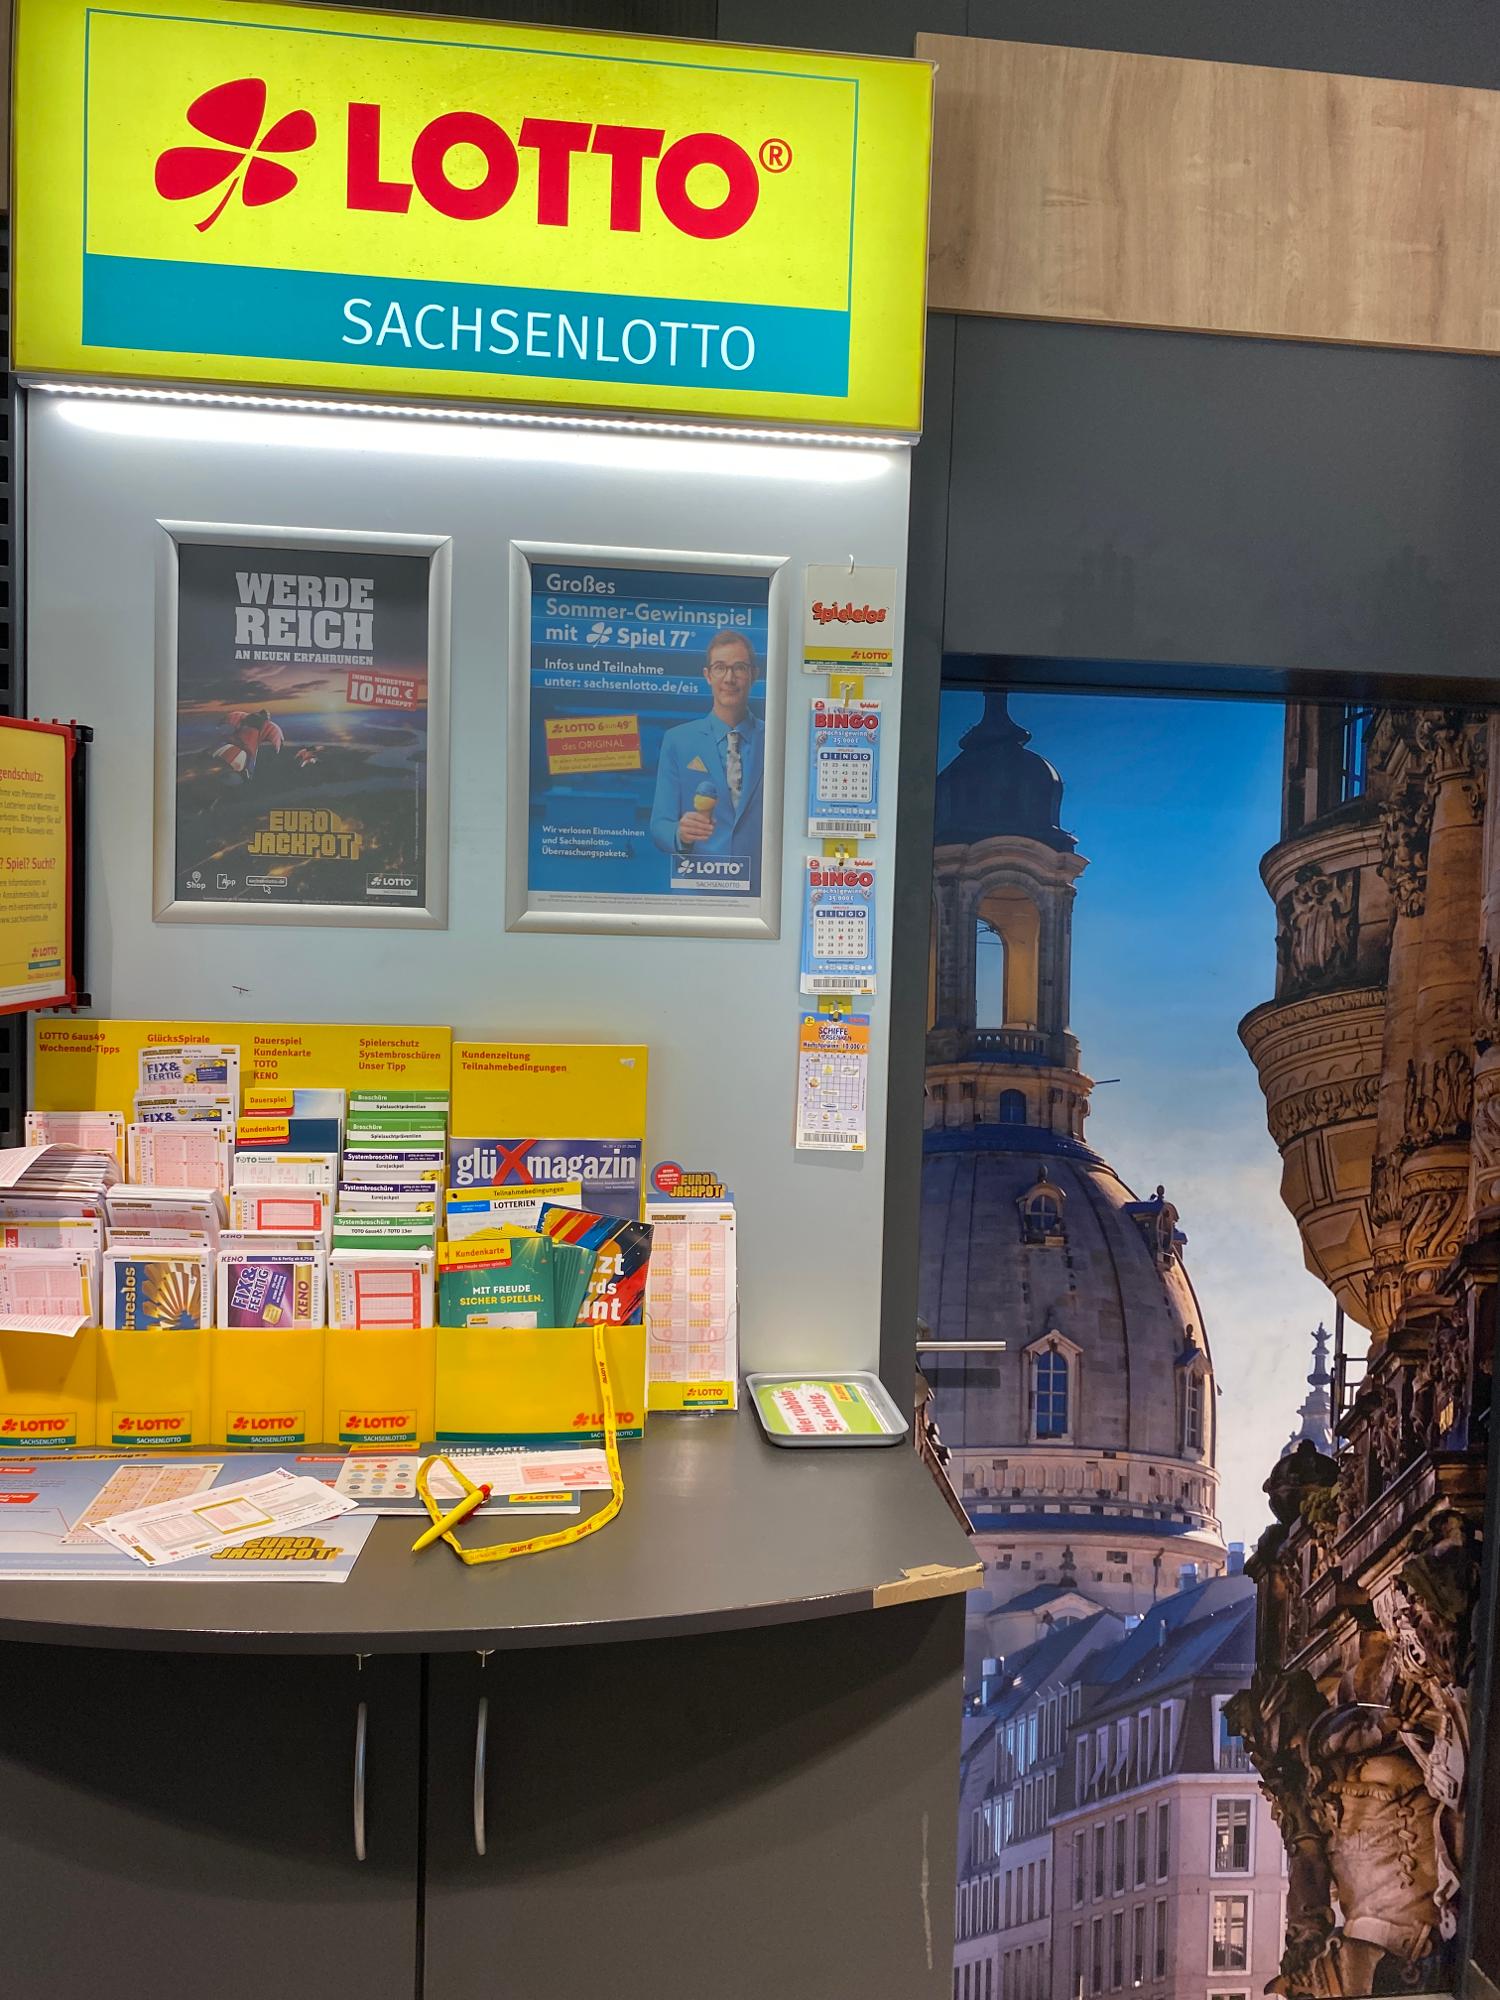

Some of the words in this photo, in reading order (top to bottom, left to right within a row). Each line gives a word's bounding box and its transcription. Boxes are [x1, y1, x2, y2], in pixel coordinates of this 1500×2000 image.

[342, 298, 757, 372] SACHSENLOTTO
[545, 573, 616, 595] Großes
[235, 572, 375, 611] WERDE
[545, 597, 753, 628] Sommer-Gewinnspiel
[234, 606, 375, 651] REICH
[545, 624, 578, 642] mit
[616, 626, 667, 650] Spiel
[234, 650, 252, 661] AN
[253, 650, 292, 663] NEUEN
[293, 652, 374, 666] ERFAHRUNGEN
[862, 652, 888, 660] LOTTO
[544, 658, 575, 672] Infos
[576, 660, 600, 673] und
[602, 659, 664, 675] Teilnahme
[351, 681, 374, 702] 10
[544, 676, 581, 689] unter:
[582, 677, 699, 695] sachsenlotto.de/eis
[815, 712, 879, 730] BINGO
[564, 722, 596, 733] LOTTO
[578, 738, 625, 750] ORIGINAL
[269, 809, 335, 834] EURO
[541, 825, 557, 833] Wir
[558, 825, 592, 835] verlosen
[592, 827, 645, 837] Eismaschinen
[247, 832, 359, 860] JACKPOT
[541, 836, 558, 845] und
[6, 856, 30, 873] Spiel?
[32, 857, 57, 870] Sucht?
[695, 860, 740, 876] LOTTO
[186, 881, 206, 891] Shop
[221, 877, 236, 887] App
[383, 877, 411, 887] LOTTO
[809, 871, 874, 887] BINGO
[39, 1031, 70, 1042] LOTTO
[71, 1032, 106, 1042] 6aus49
[818, 1027, 848, 1036] SCHIFFE
[147, 1033, 211, 1045] GlücksSpirale
[253, 1035, 303, 1047] Dauerspiel
[359, 1038, 420, 1050] Spielerschutz
[39, 1044, 121, 1055] Wochenend-Tipps
[253, 1047, 312, 1058] Kundenkarte
[358, 1049, 442, 1061] Systembroschüren
[461, 1050, 531, 1062] Kundenzeitung
[253, 1059, 279, 1069] TOTO
[358, 1062, 385, 1071] Unser
[386, 1062, 407, 1073] Tipp
[461, 1062, 568, 1074] Teilnahmebedingungen
[148, 1072, 183, 1082] FERTIG
[252, 1070, 279, 1080] KENO
[249, 1095, 288, 1105] Dauerspiel
[239, 1123, 286, 1134] Kundenkarte
[235, 1156, 257, 1164] TOTO
[347, 1153, 399, 1161] Systembroschüre
[681, 1174, 715, 1186] EURO
[343, 1184, 394, 1192] Systembroschüre
[493, 1186, 565, 1197] Teilnahmebedingungen
[669, 1184, 724, 1198] JACKPOT
[493, 1200, 536, 1209] LOTTERIEN
[338, 1218, 391, 1226] Systembroschüre
[455, 1246, 505, 1258] Kundenkarte
[220, 1255, 244, 1263] KENO
[248, 1268, 270, 1312] FERTIG
[472, 1286, 492, 1295] MIT
[493, 1285, 531, 1294] FREUDE
[298, 1280, 309, 1317] KENO
[460, 1296, 499, 1306] SICHER
[500, 1295, 544, 1305] SPIELEN.
[697, 1388, 723, 1396] LOTTO
[780, 1390, 804, 1416] rubbeln
[136, 1418, 182, 1431] LOTTO
[251, 1417, 295, 1430] LOTTO
[364, 1416, 407, 1429] LOTTO
[591, 1411, 634, 1426] LOTO
[20, 1419, 66, 1432] LOTTO
[824, 1418, 843, 1433] Sie
[20, 1438, 66, 1446] SACHSENLOTTO
[136, 1436, 182, 1444] SACHSENLOTTO
[251, 1435, 296, 1443] SACHSENLOTTO
[364, 1434, 407, 1442] SACHSENLOTTO
[211, 1548, 343, 1561] JACKPOT
